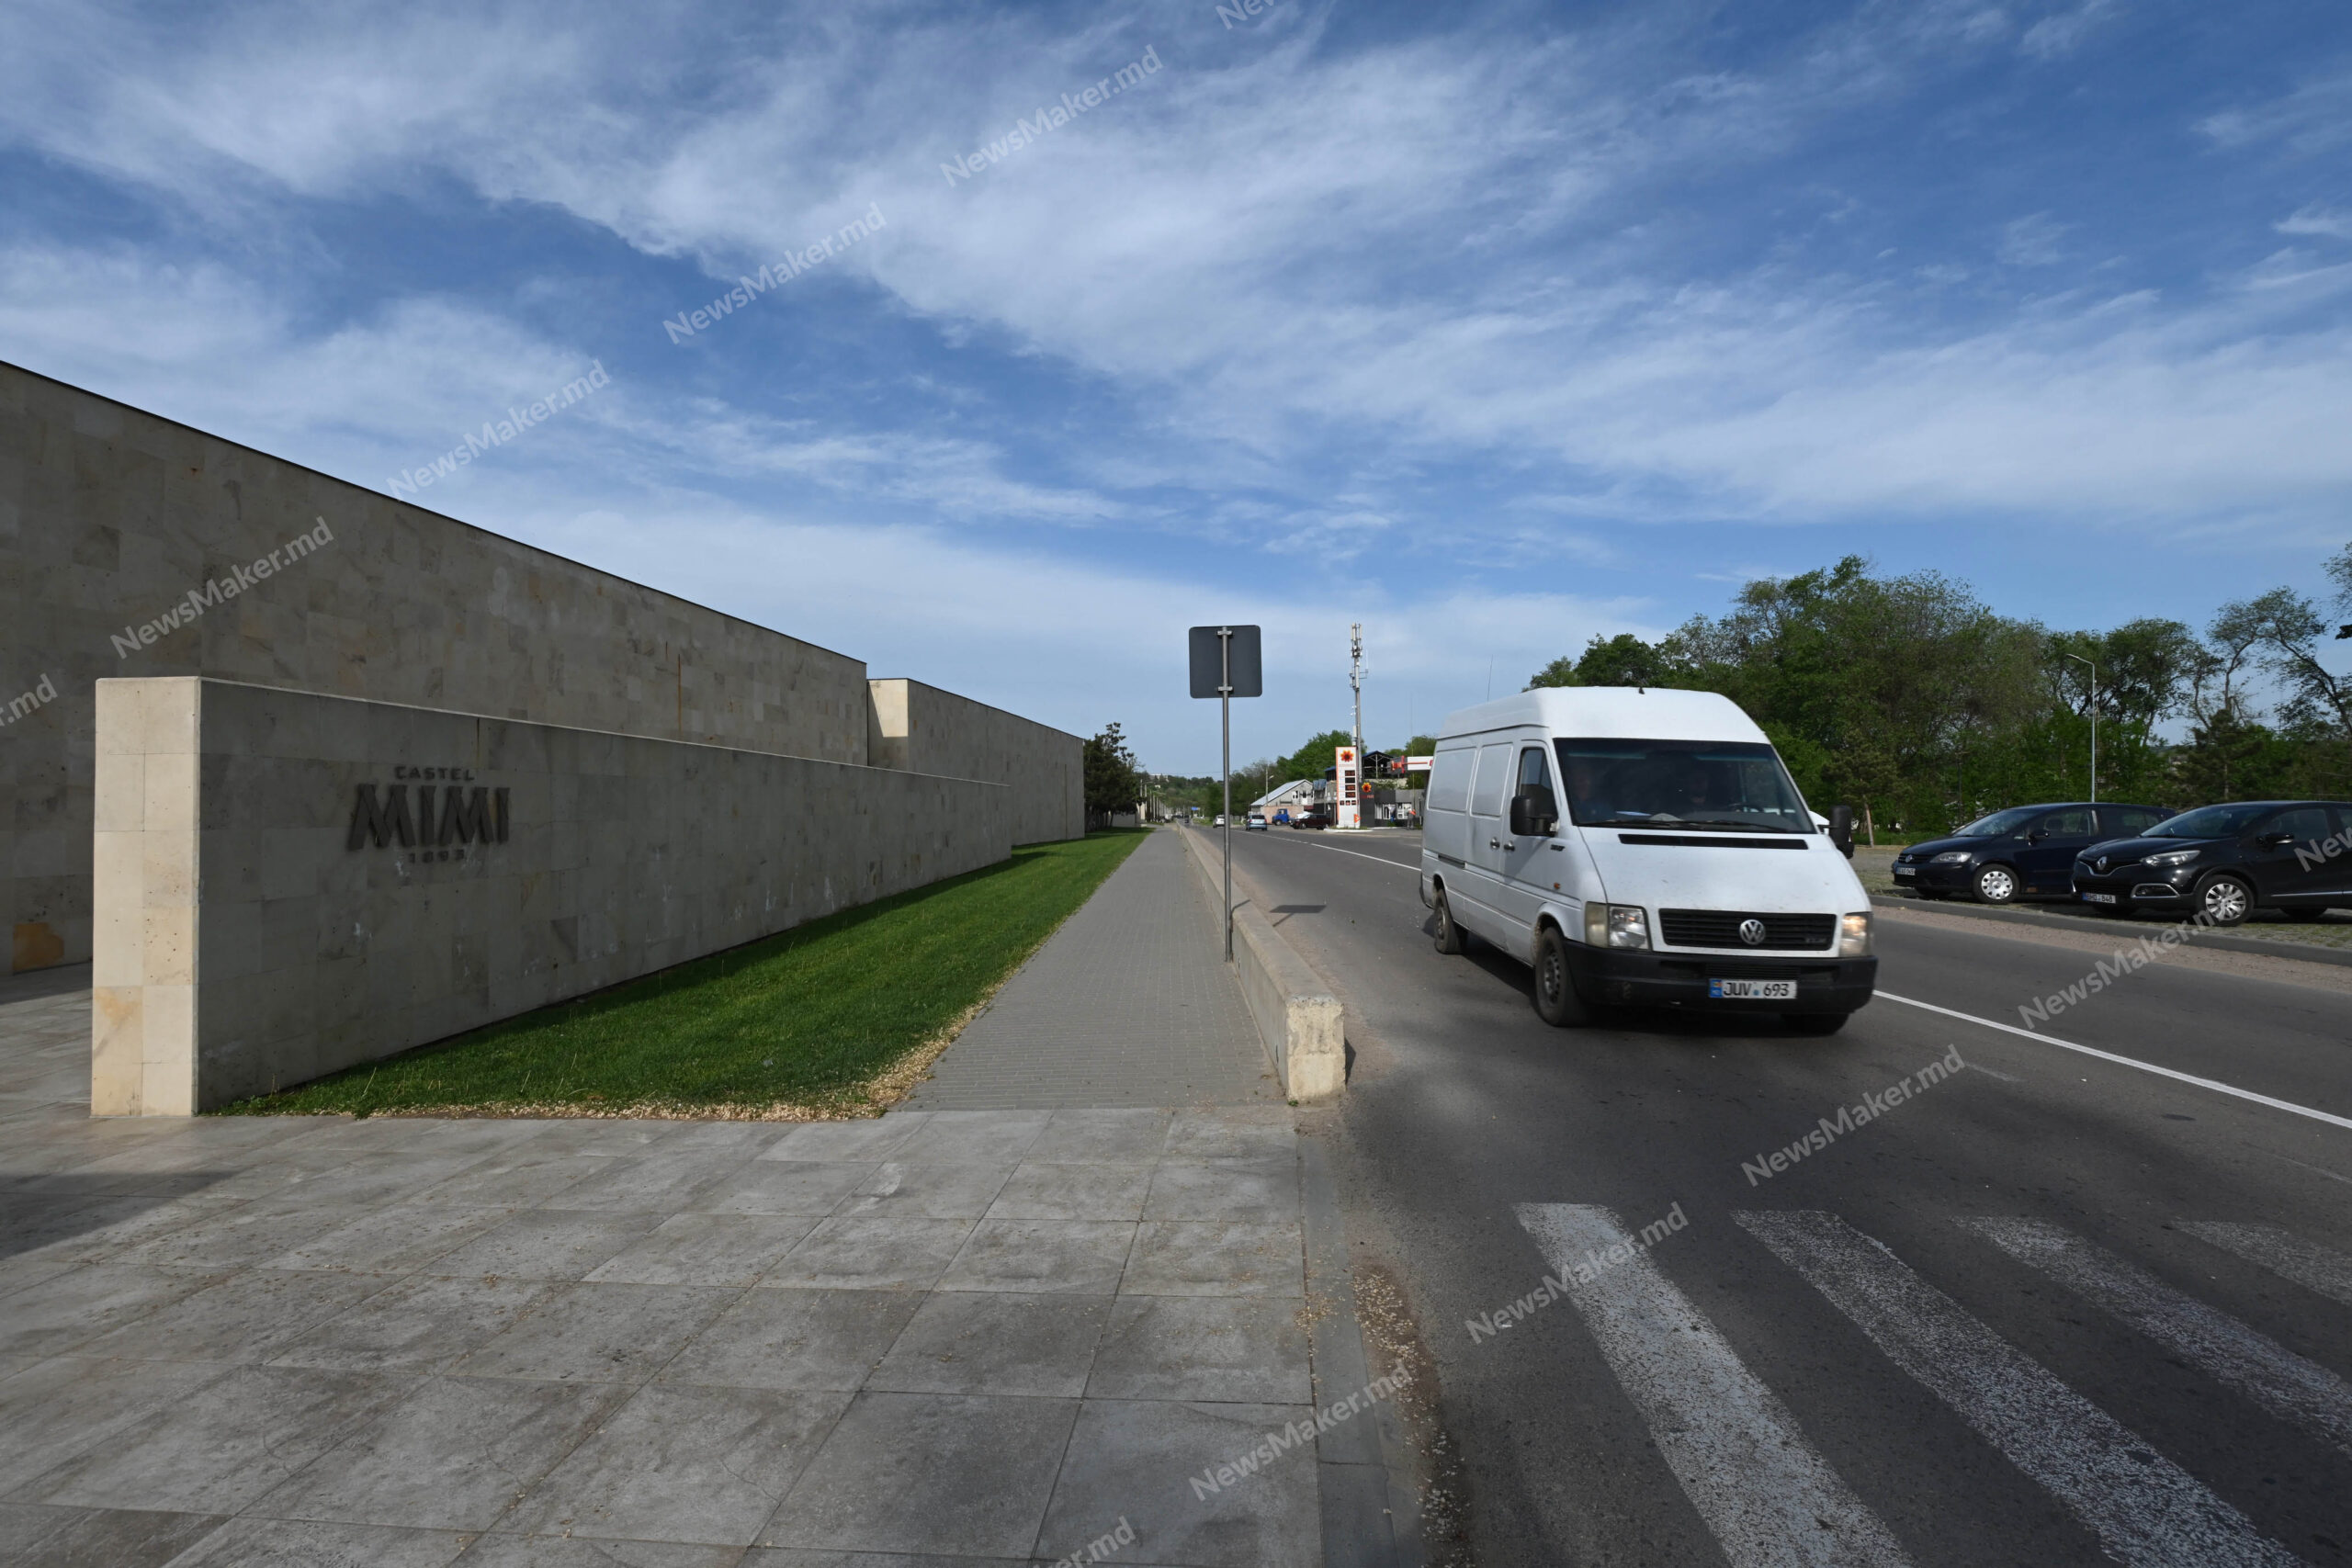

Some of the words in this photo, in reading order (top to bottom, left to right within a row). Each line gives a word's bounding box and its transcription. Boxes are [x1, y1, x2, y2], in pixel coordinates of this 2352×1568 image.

[395, 765, 475, 782] CASTEL
[347, 783, 511, 851] MIMI
[1723, 982, 1752, 996] JUV
[1763, 983, 1790, 997] 693
